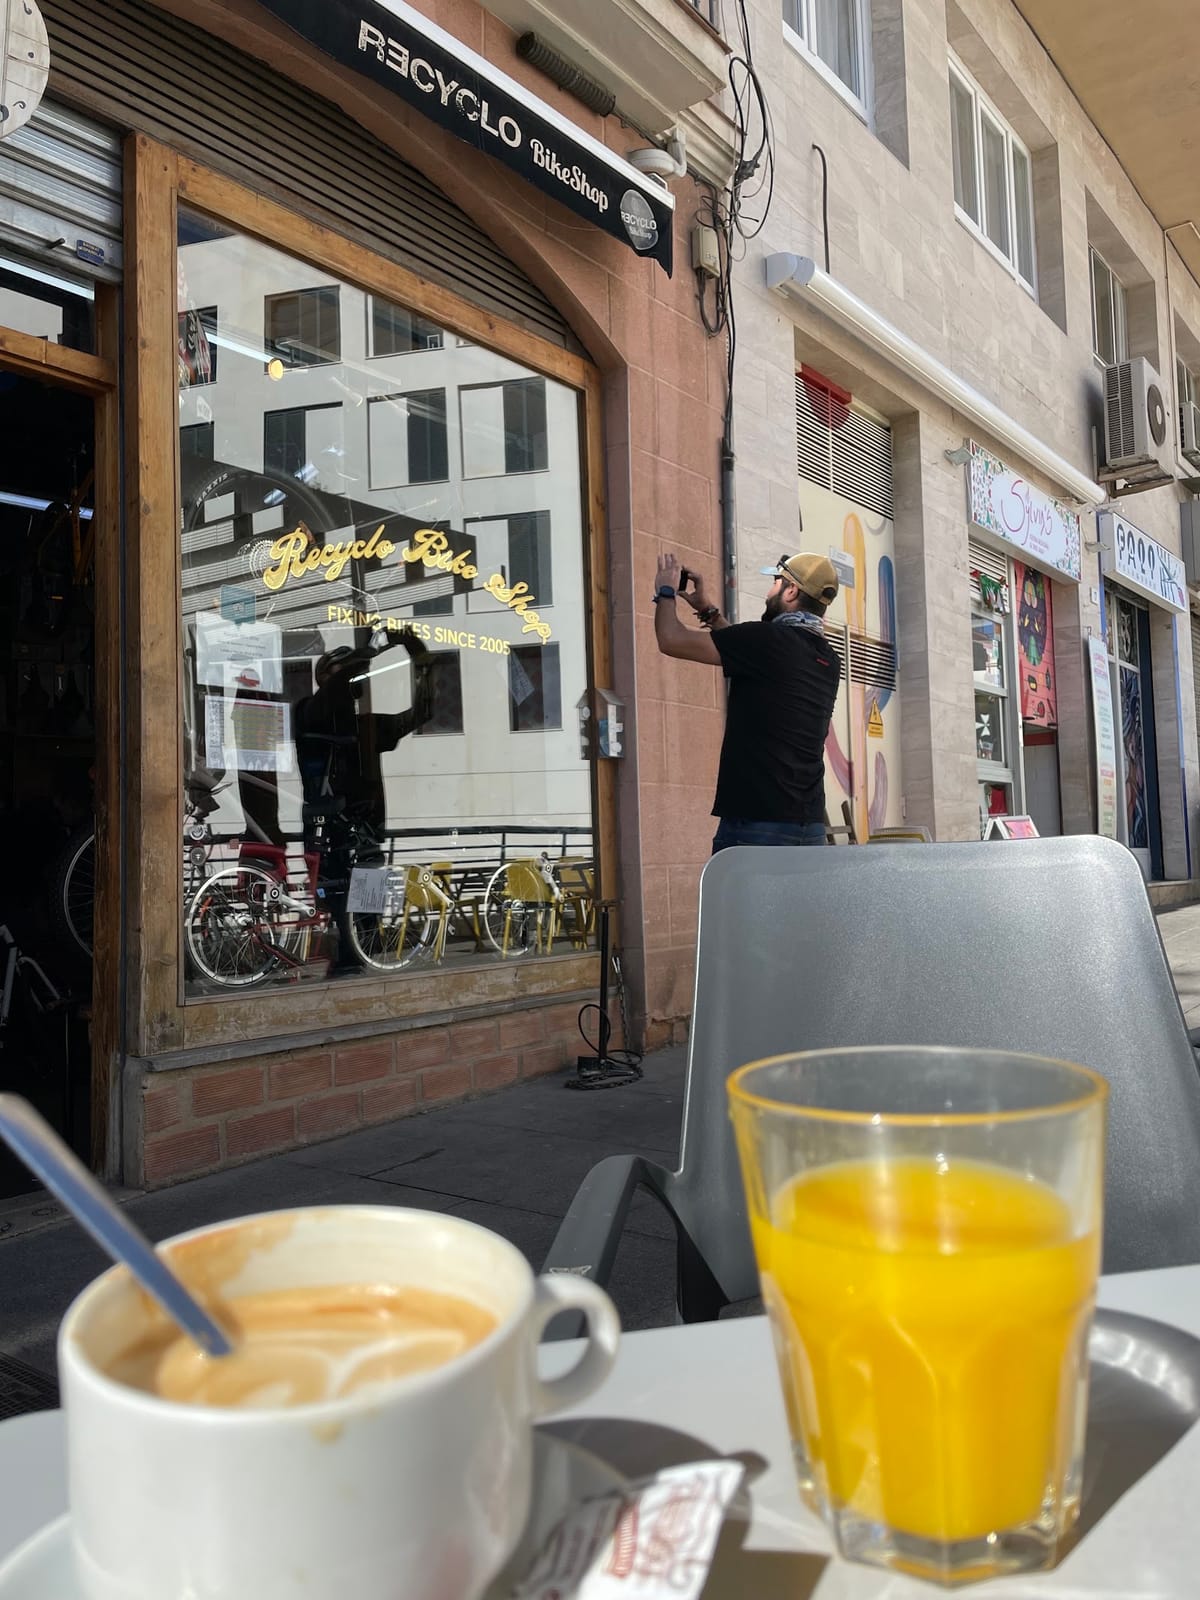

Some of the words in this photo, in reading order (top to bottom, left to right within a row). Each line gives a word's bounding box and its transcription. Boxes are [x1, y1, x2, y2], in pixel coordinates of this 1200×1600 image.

[263, 524, 396, 590] Recyclo
[402, 529, 479, 580] Bike
[483, 573, 552, 645] Shop
[327, 605, 382, 631] FIXING
[387, 616, 431, 640] BIKES
[434, 626, 476, 649] SINCE
[479, 635, 511, 656] 2005
